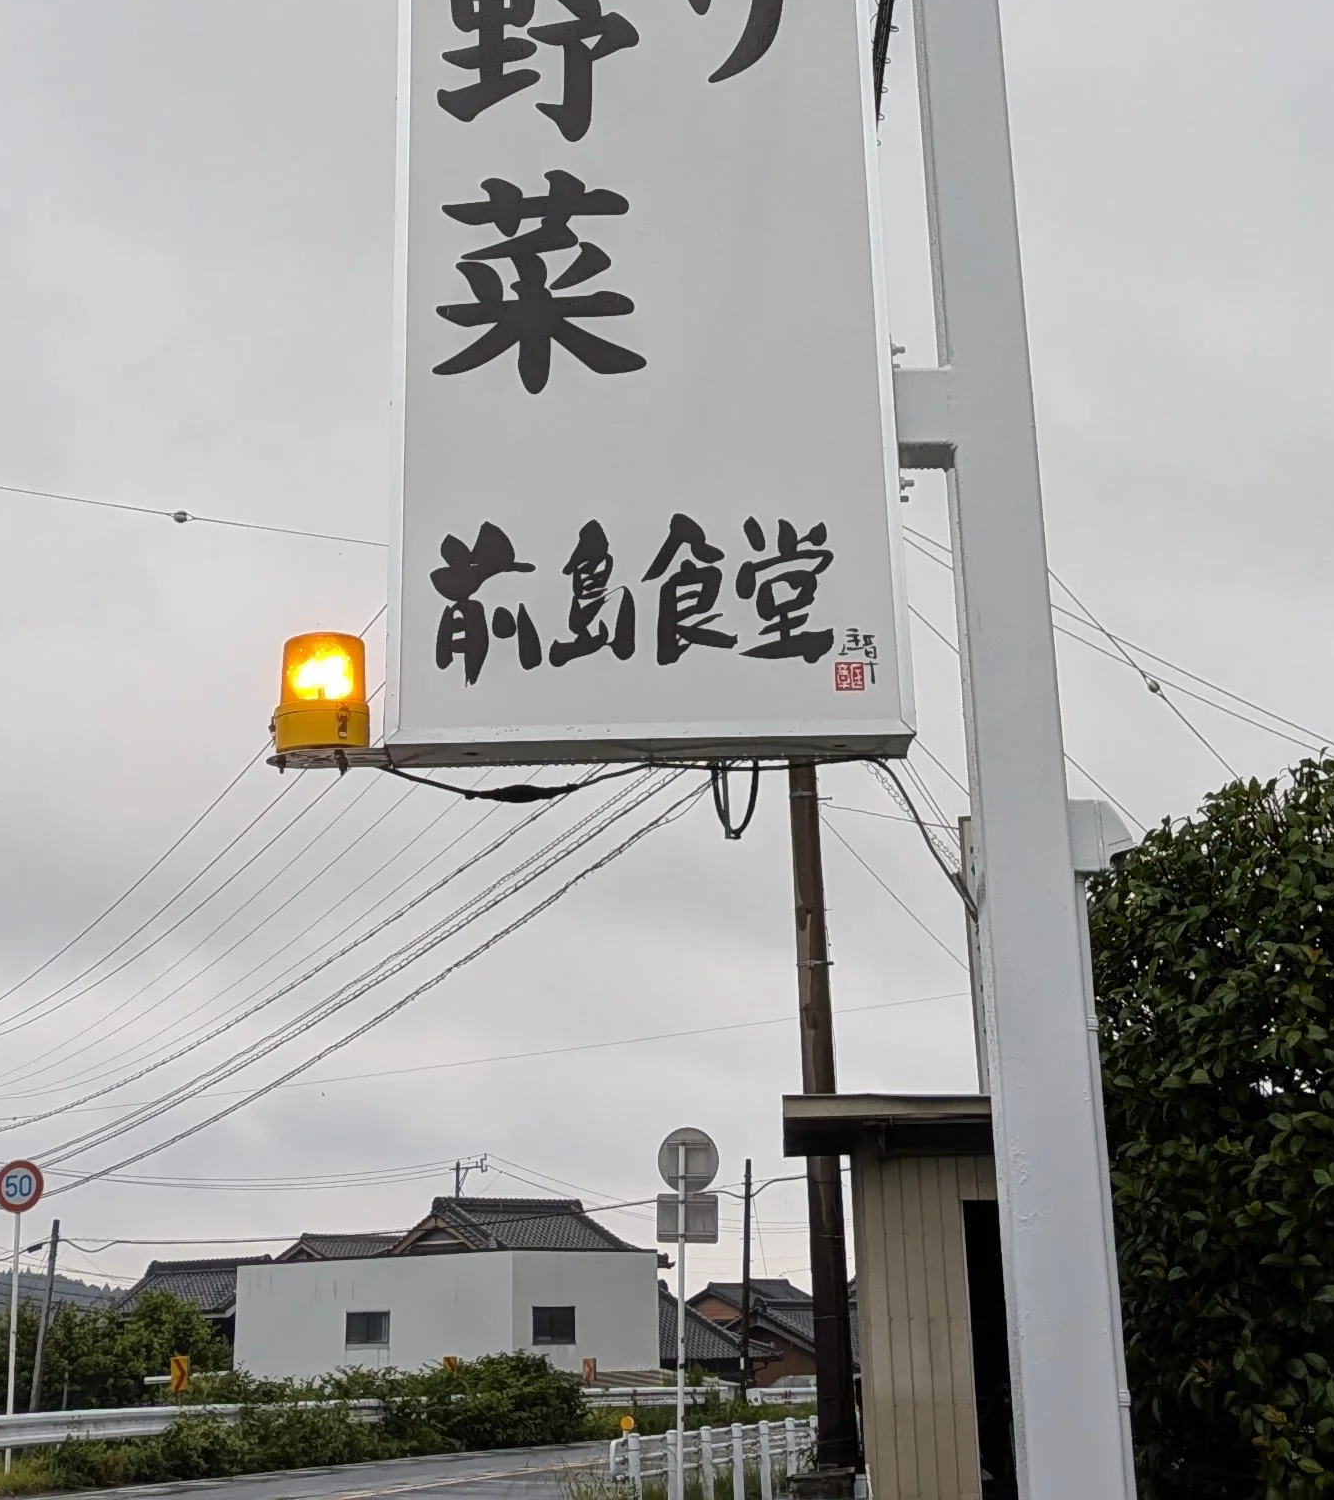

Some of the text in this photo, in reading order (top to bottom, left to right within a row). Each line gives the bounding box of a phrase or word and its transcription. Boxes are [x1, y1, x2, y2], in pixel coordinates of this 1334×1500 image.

[429, 513, 835, 688] 前島食堂
[5, 1174, 33, 1198] 50
